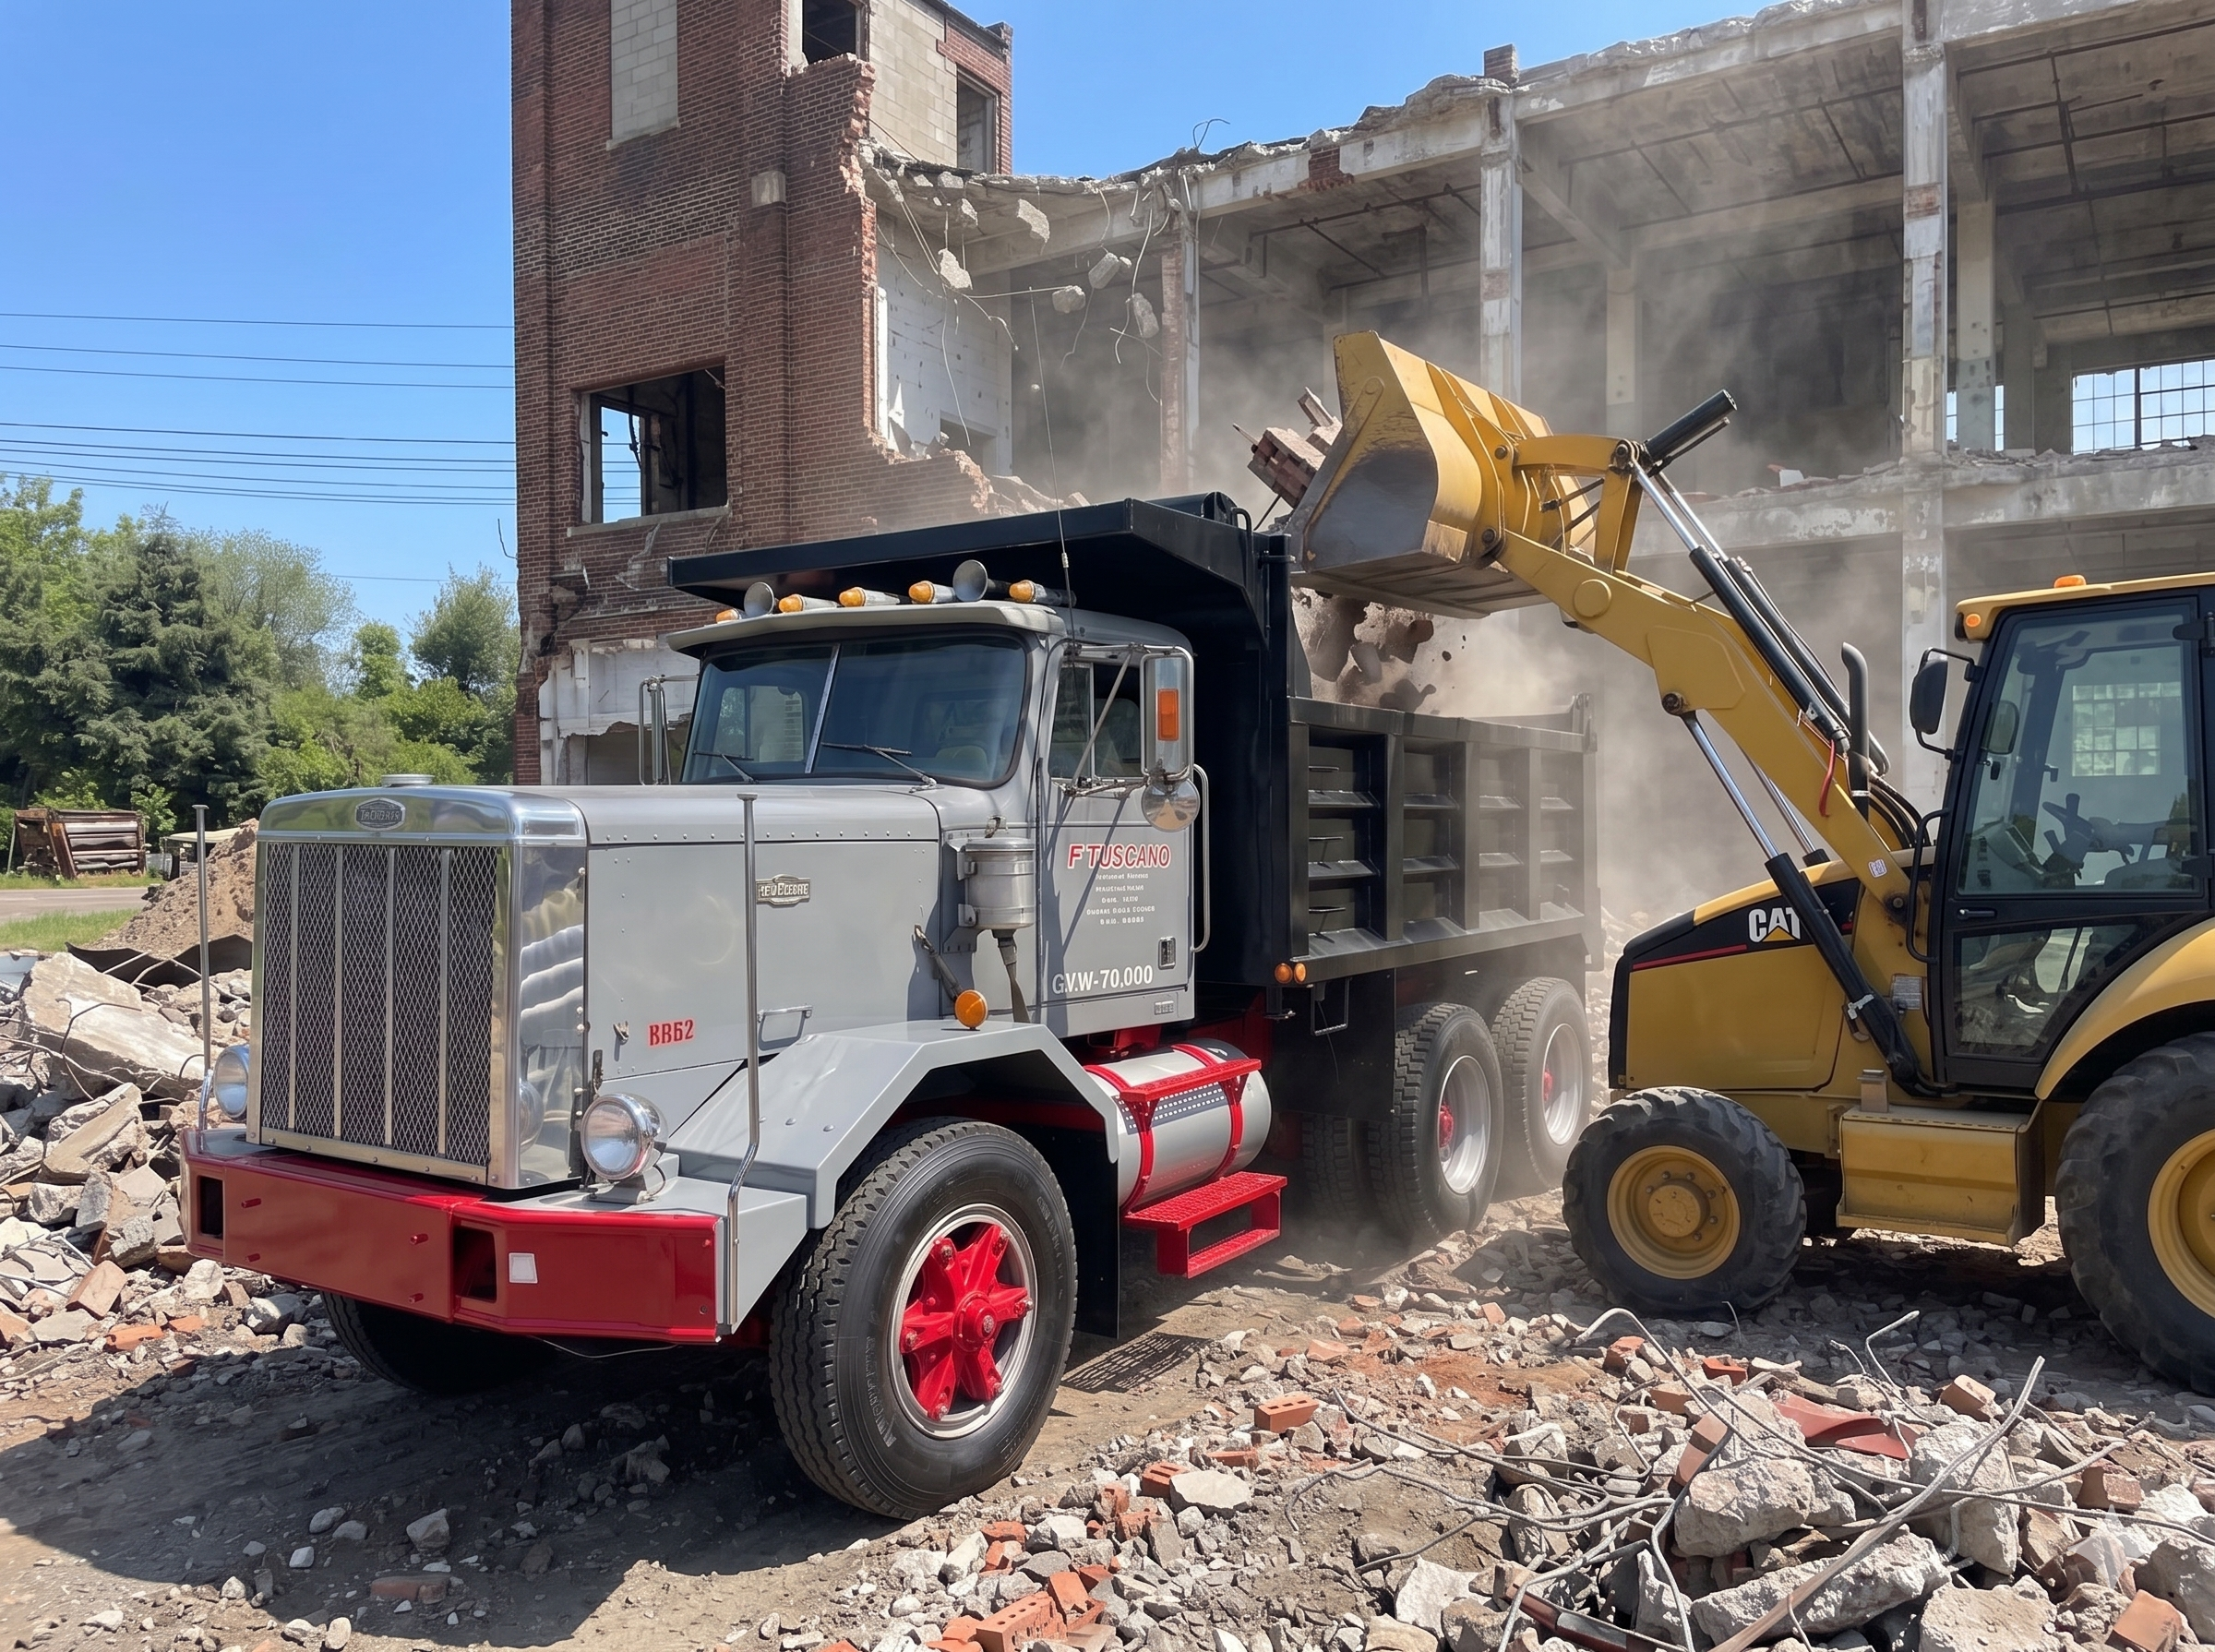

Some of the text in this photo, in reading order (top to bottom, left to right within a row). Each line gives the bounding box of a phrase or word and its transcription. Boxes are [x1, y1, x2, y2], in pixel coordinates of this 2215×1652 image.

[1068, 844, 1170, 869] F TUSCANO
[1749, 907, 1801, 942] CAT
